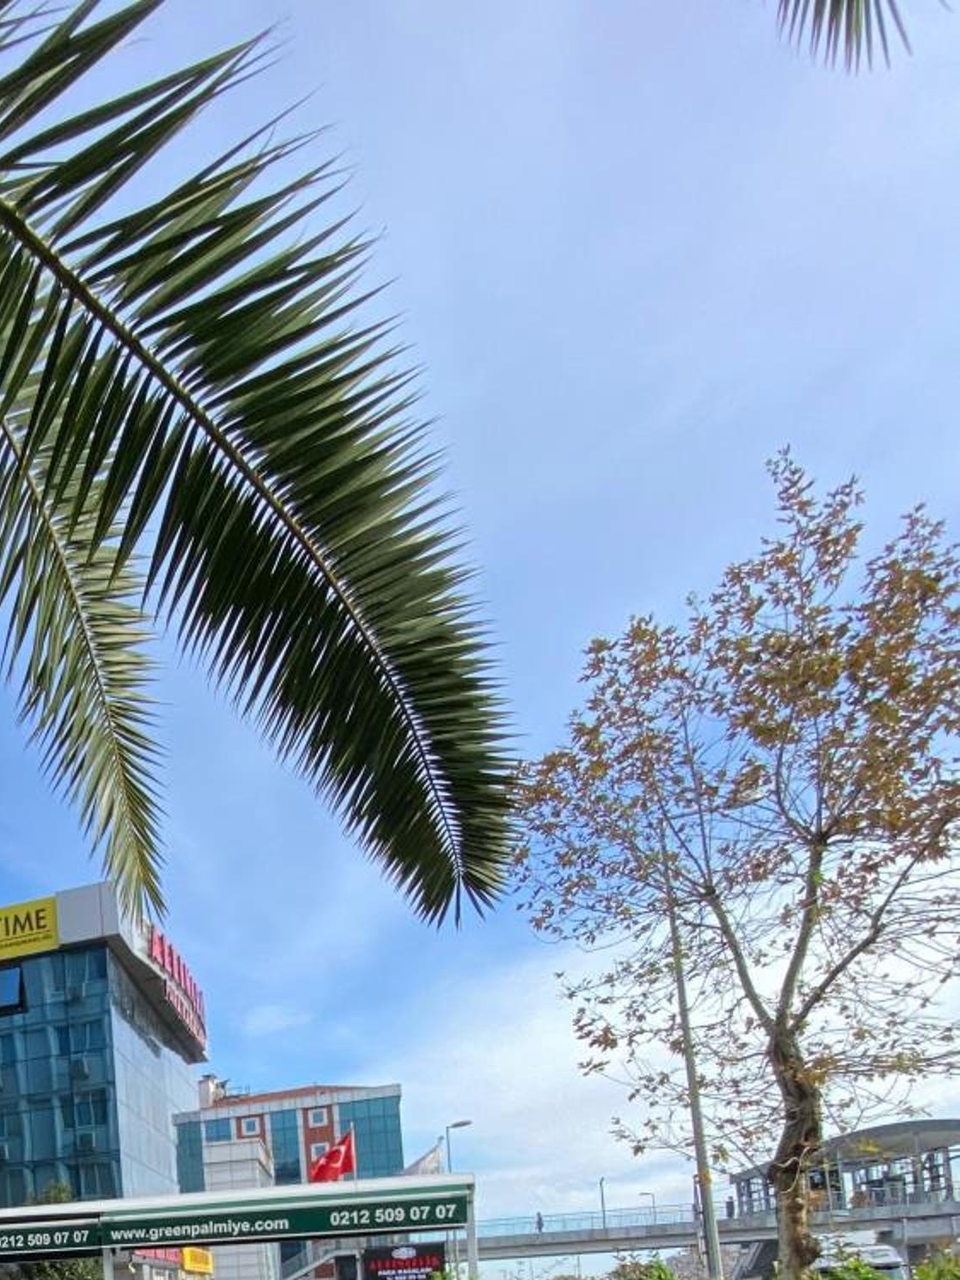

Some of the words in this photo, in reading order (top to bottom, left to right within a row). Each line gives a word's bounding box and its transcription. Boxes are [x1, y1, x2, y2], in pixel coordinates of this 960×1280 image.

[110, 1216, 289, 1241] www.greenpalmiye.com
[330, 1209, 370, 1226] 0212
[374, 1207, 405, 1222] 509
[409, 1206, 429, 1221] 07
[435, 1204, 457, 1219] 07
[27, 1232, 51, 1246] 509
[53, 1231, 70, 1245] 07
[73, 1229, 89, 1243] 07
